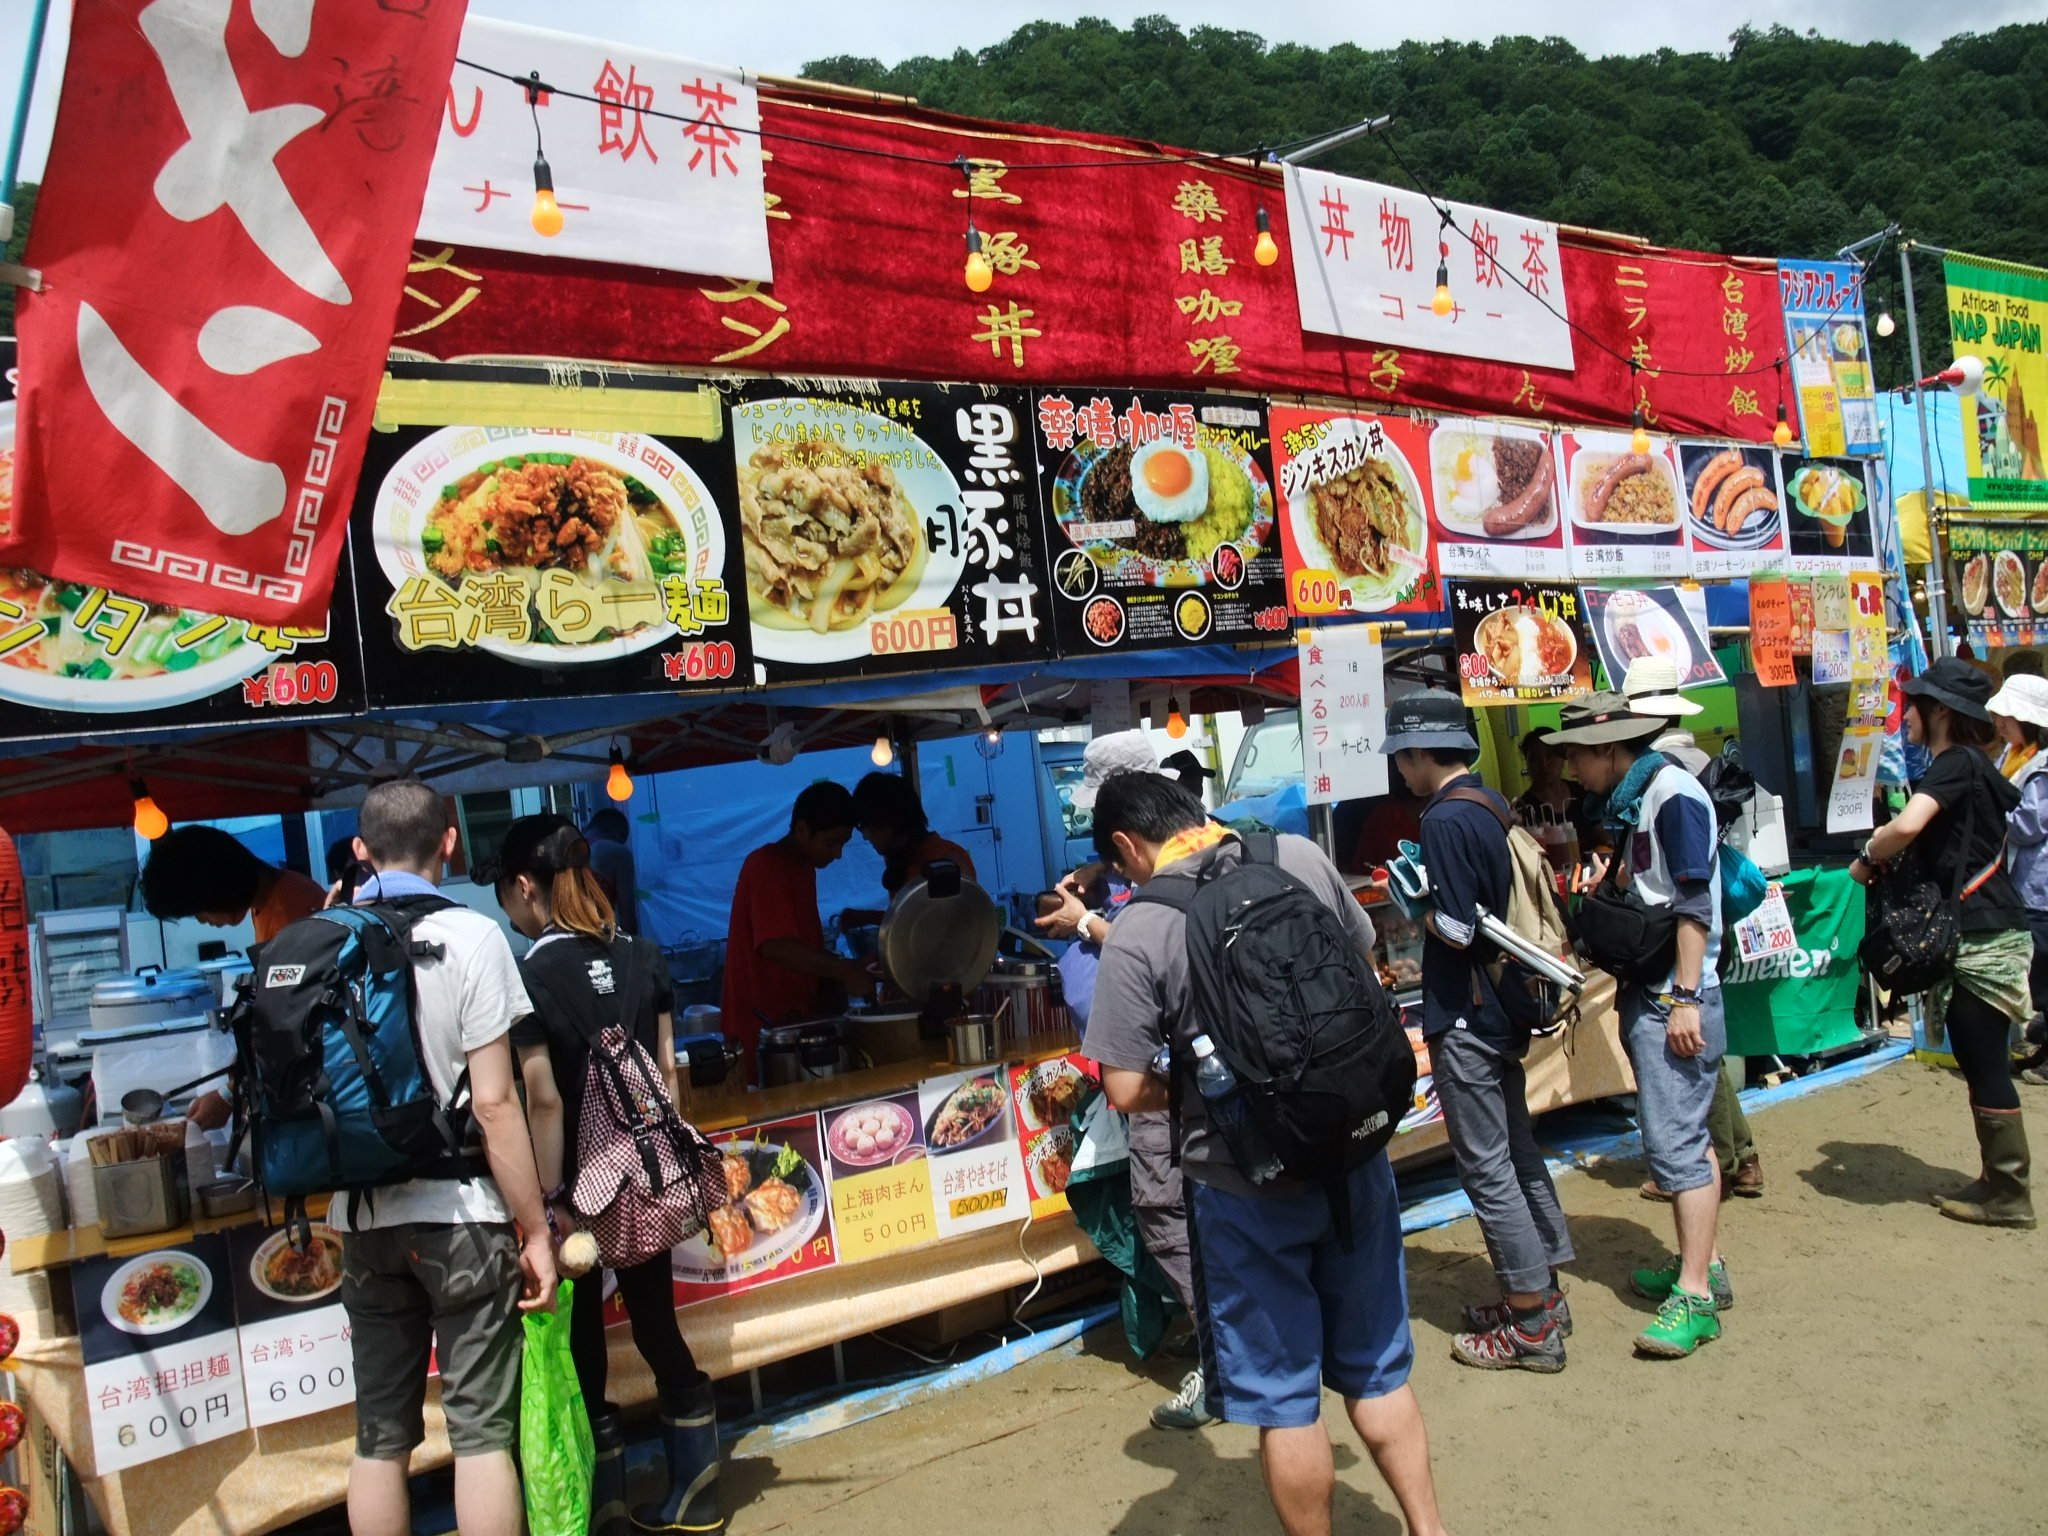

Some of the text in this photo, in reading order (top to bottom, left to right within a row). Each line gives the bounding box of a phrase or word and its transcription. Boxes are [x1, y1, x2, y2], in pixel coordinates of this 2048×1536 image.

[1961, 291, 2030, 320] African Food
[1720, 270, 1764, 418] 台湾炒飯
[1951, 309, 2042, 354] NAP JAPAN
[1199, 427, 1271, 451] アジアンカレー
[1278, 422, 1385, 498] ジンギスカン丼
[924, 403, 1040, 647] 黒豚丼
[870, 613, 956, 654] 600円
[1306, 644, 1332, 795] 食べるラー油
[1340, 736, 1372, 755] サービス
[1836, 802, 1863, 817] 300円
[841, 1176, 924, 1212] 上海肉まん
[863, 1213, 927, 1244] 500円
[97, 1351, 232, 1411] 台湾担担麺
[117, 1392, 231, 1448] 600円
